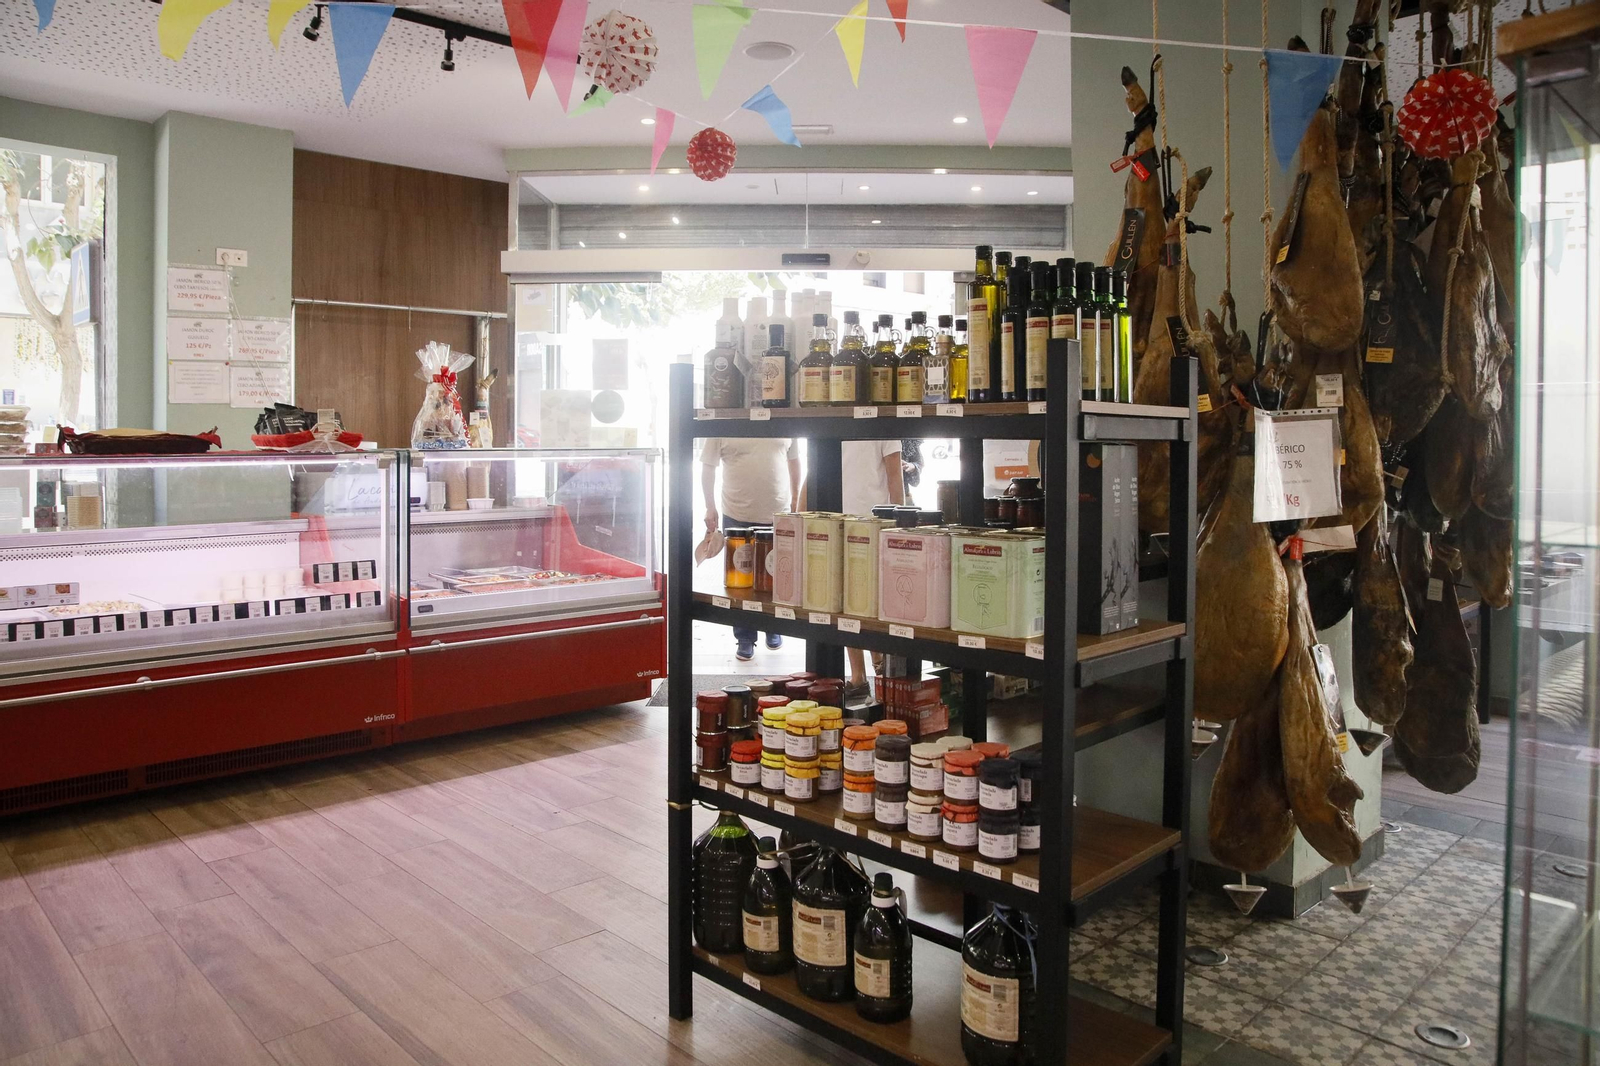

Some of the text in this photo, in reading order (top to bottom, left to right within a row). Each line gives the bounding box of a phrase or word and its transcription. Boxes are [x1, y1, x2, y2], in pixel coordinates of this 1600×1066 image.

[1121, 219, 1137, 259] GUILLÉN
[1283, 460, 1303, 469] 75 %
